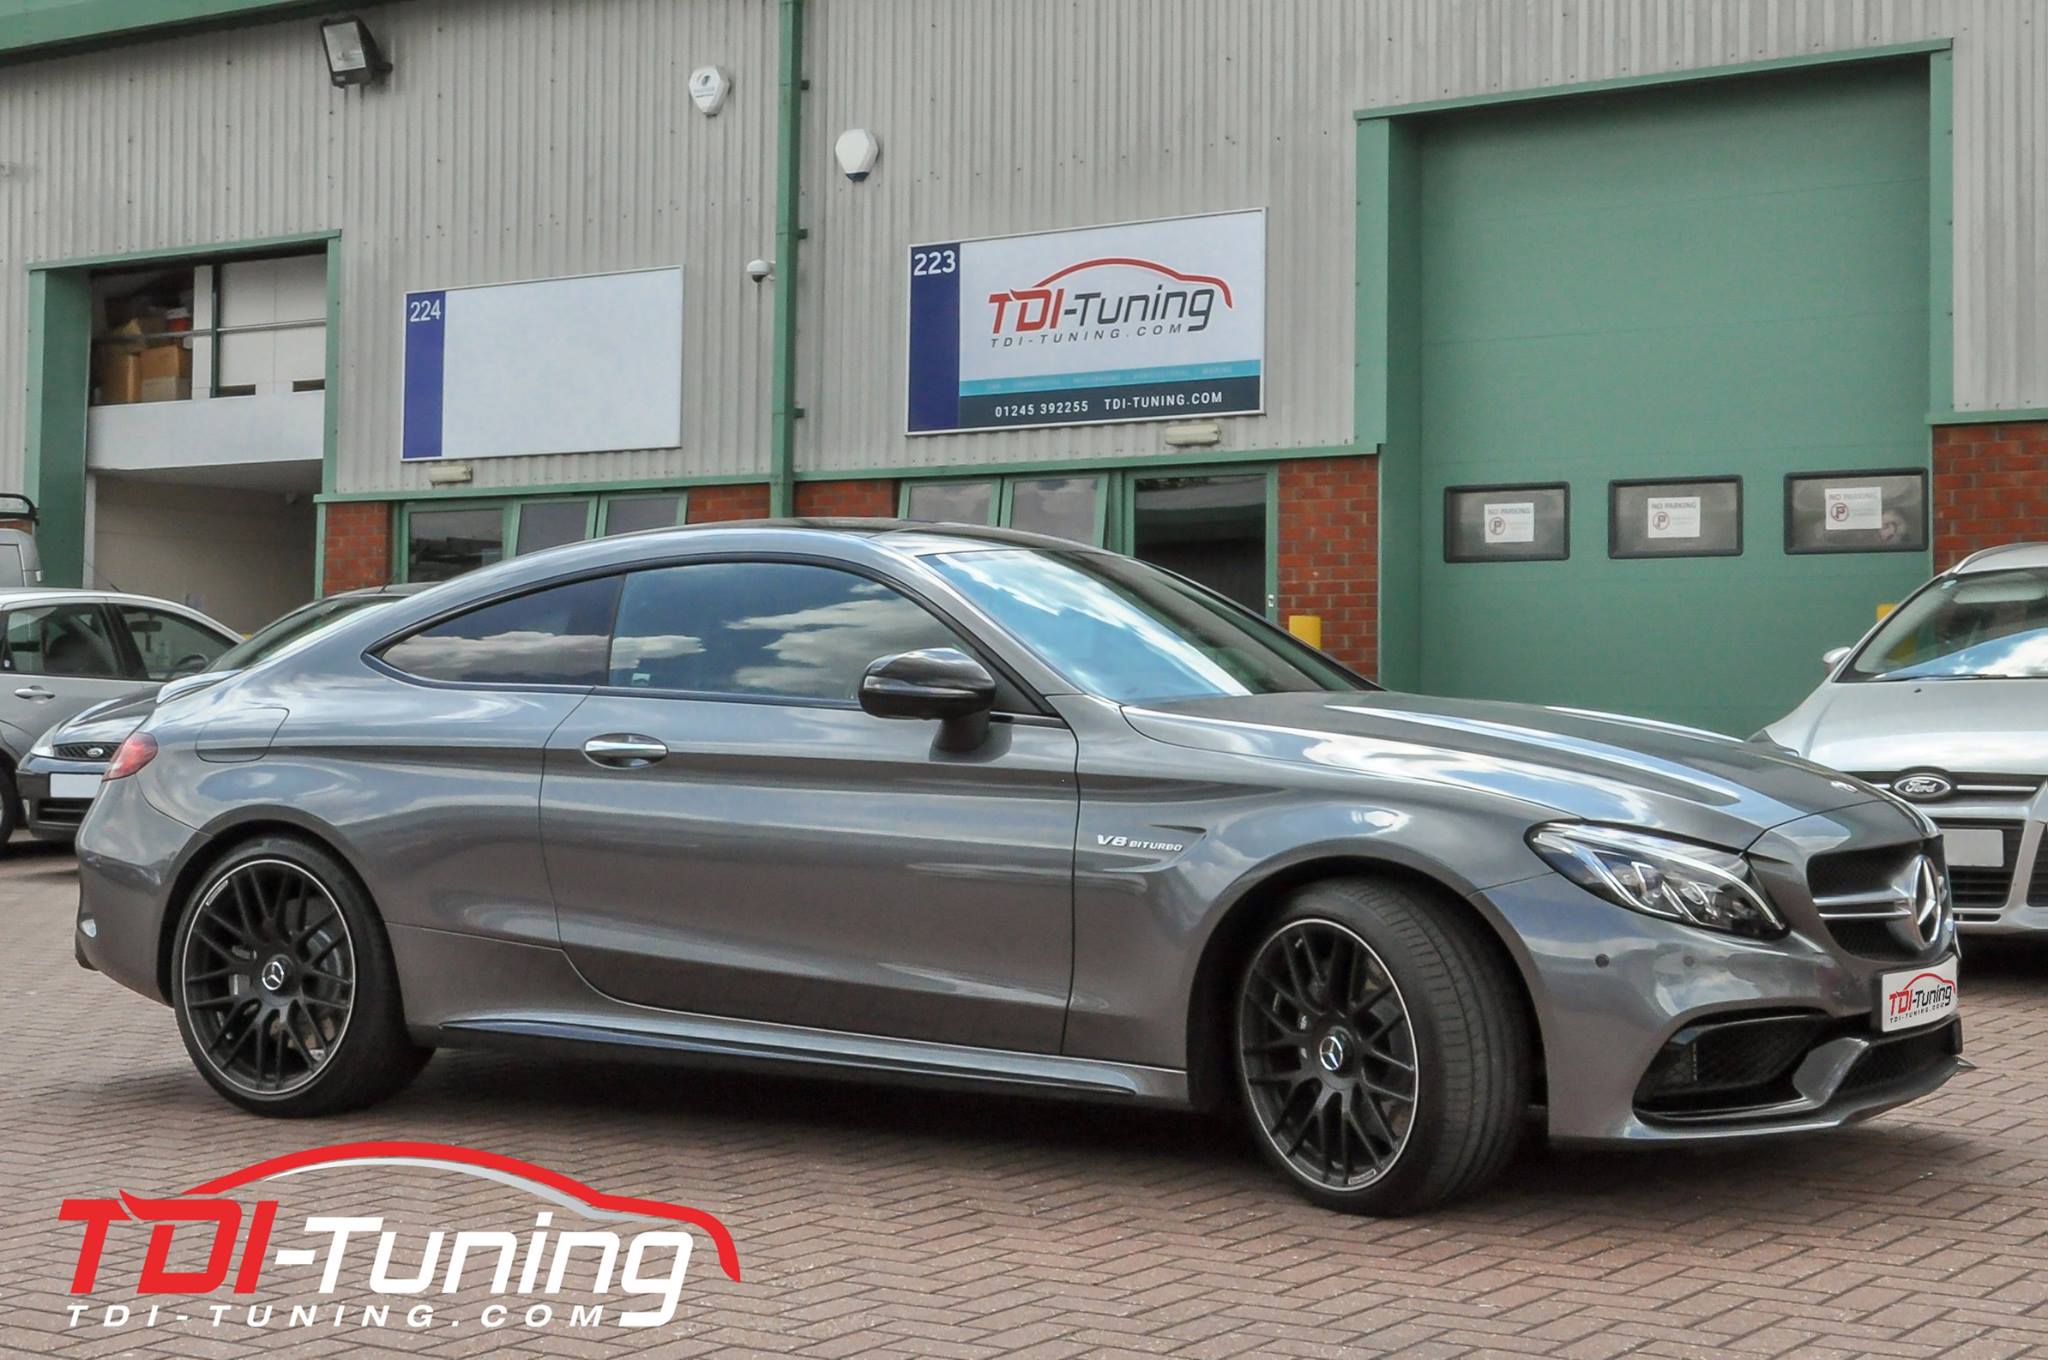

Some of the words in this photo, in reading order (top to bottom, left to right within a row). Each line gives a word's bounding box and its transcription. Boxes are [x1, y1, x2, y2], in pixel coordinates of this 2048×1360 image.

[913, 251, 956, 276] 223
[409, 299, 441, 322] 224
[988, 284, 1215, 334] TDI-Tuning
[990, 323, 1182, 349] TDI-TUNING.COM
[995, 403, 1035, 418] 01245
[1040, 400, 1089, 415] 392255
[1104, 391, 1223, 411] TDI-TUNING.COM
[1905, 779, 1936, 793] Ford
[1097, 834, 1128, 847] V8
[1129, 840, 1183, 852] BITURBO
[1889, 984, 1952, 1017] TDI-Tuning
